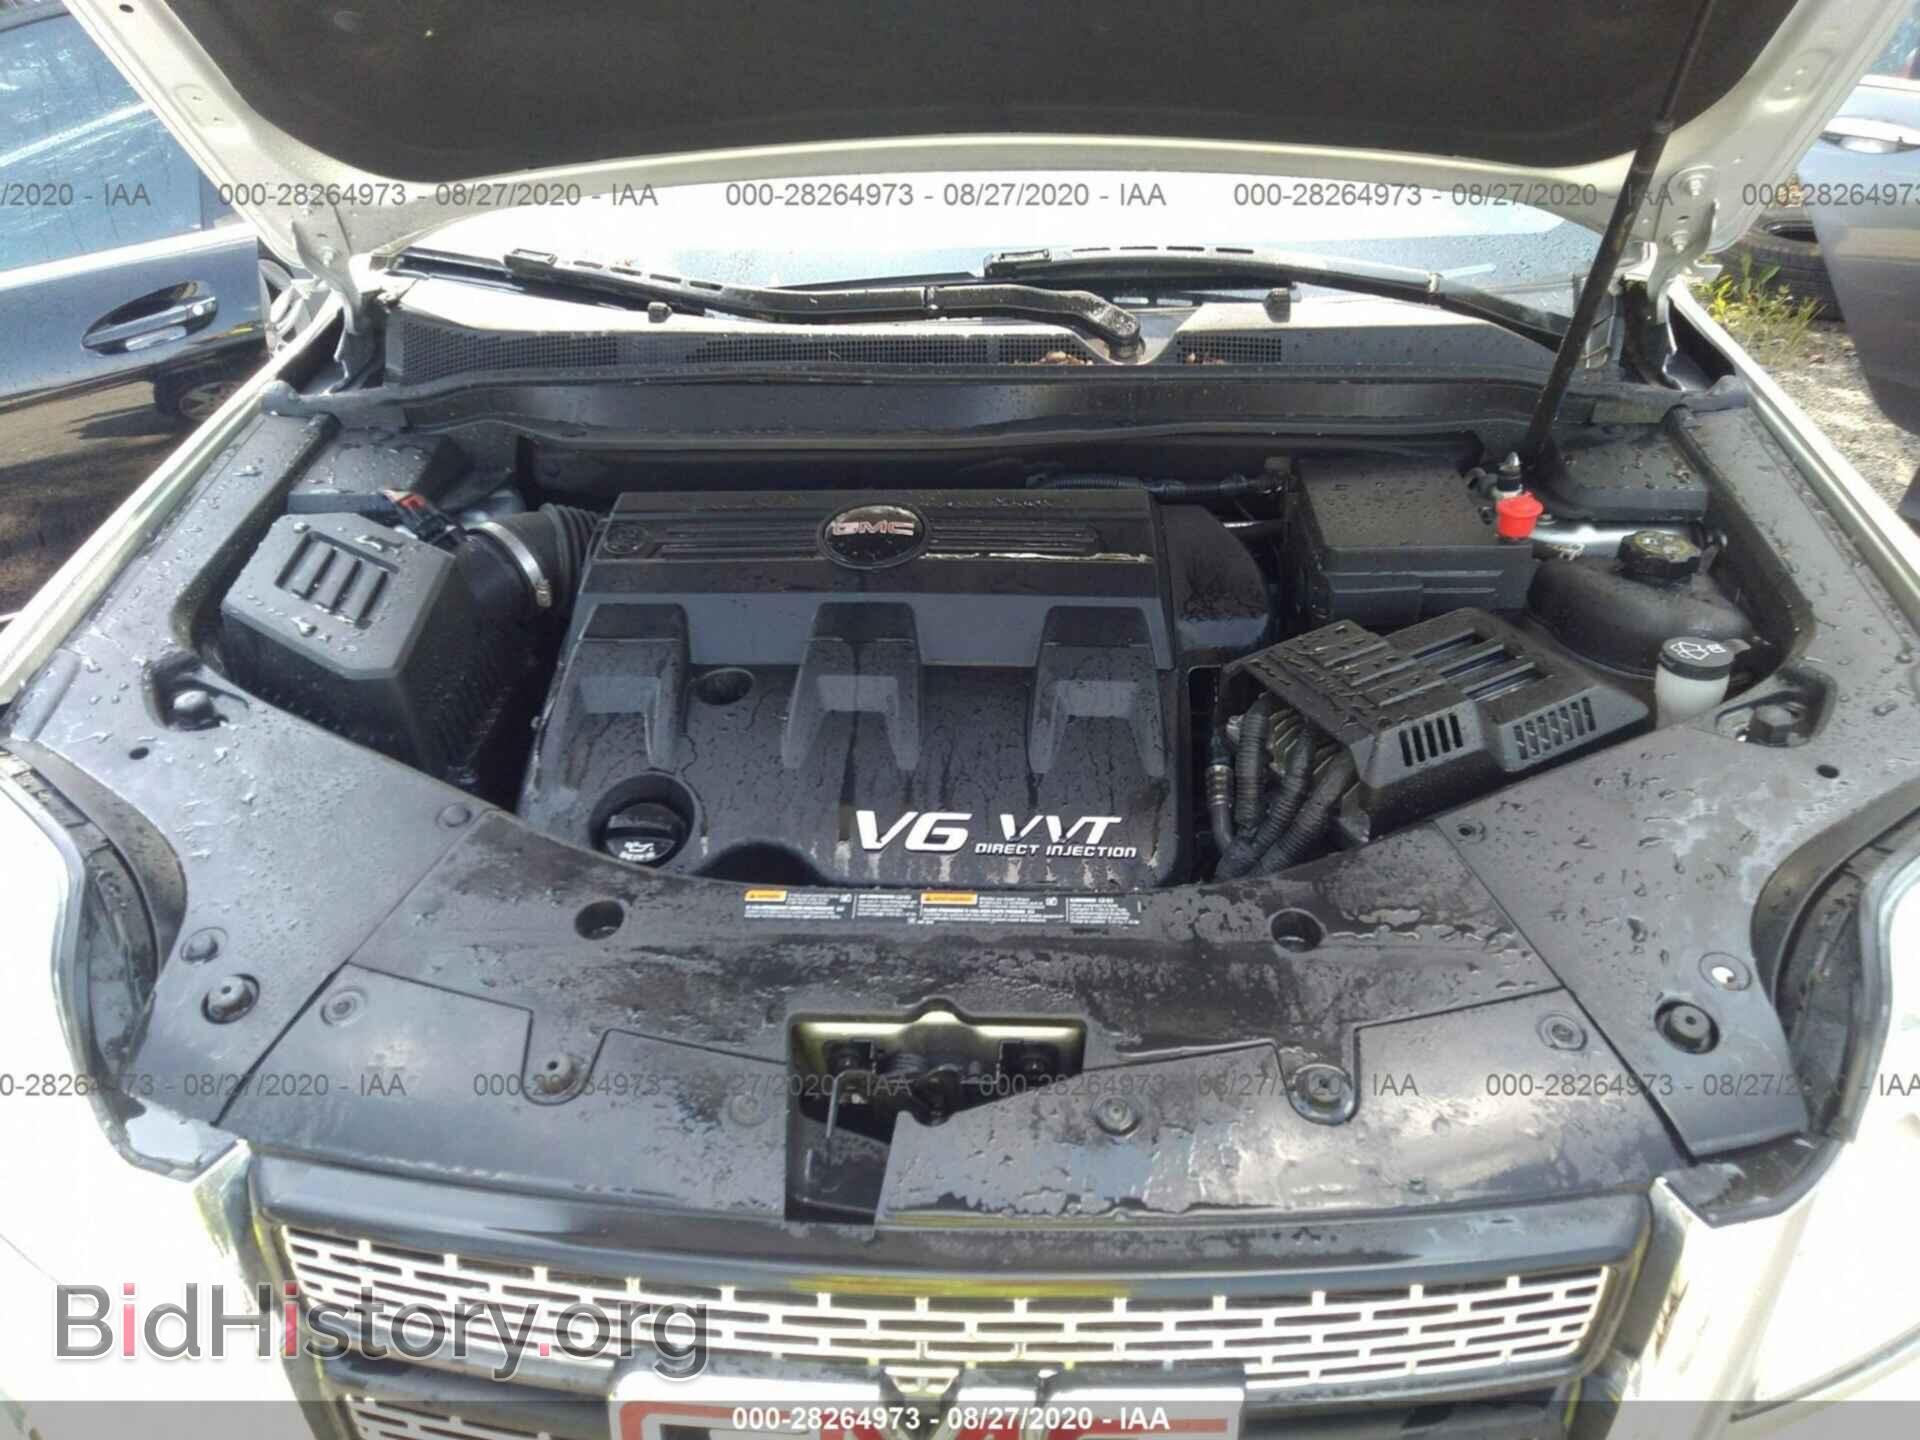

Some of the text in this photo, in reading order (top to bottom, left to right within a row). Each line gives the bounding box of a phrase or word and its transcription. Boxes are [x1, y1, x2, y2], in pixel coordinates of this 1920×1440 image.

[832, 520, 915, 537] GMC
[856, 809, 1123, 851] V6 VVT
[974, 842, 1138, 859] DIRECT INJECTION
